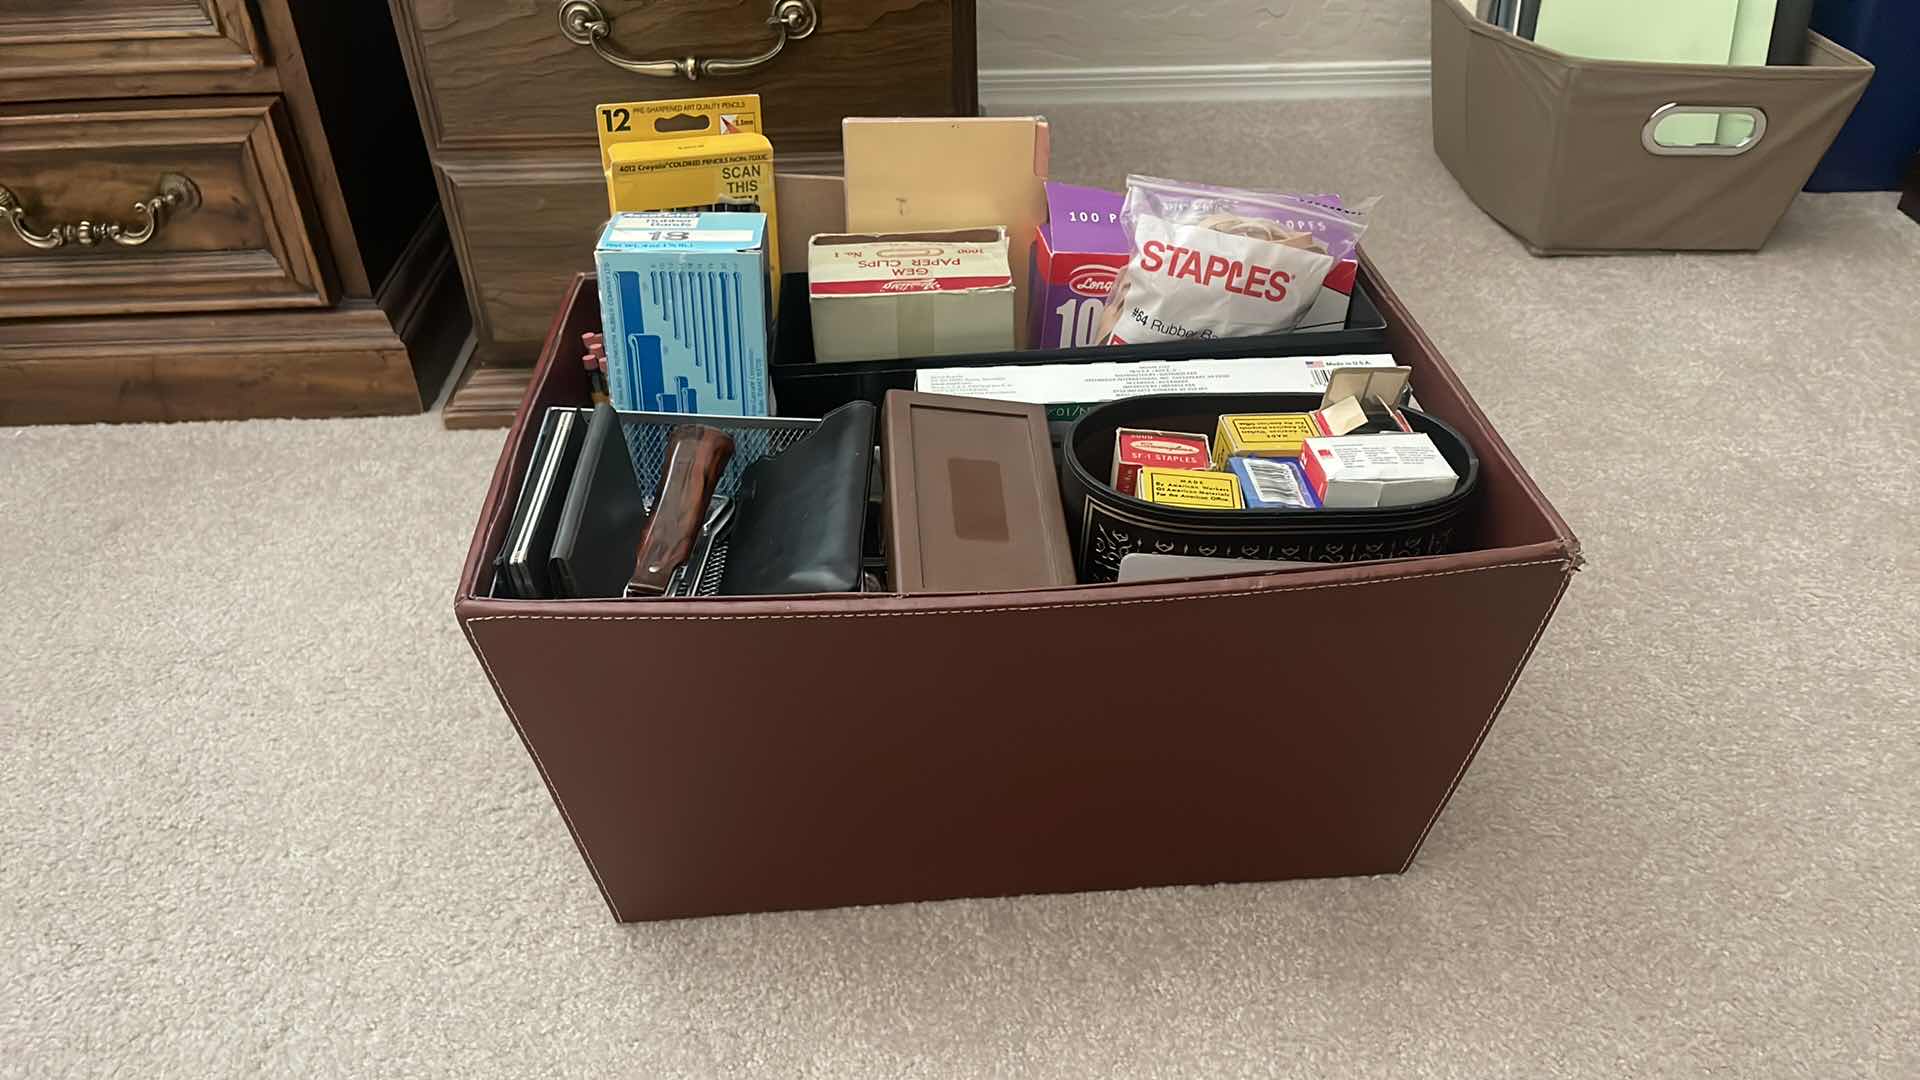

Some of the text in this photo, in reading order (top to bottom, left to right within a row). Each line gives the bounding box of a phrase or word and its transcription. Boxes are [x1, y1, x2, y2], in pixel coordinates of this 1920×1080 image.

[602, 108, 632, 133] 12
[668, 160, 701, 168] COLORED
[702, 156, 728, 165] PENCILS
[722, 165, 761, 180] SCAN
[726, 180, 758, 194] THIS
[1068, 211, 1100, 223] 100
[1109, 213, 1117, 223] P
[648, 231, 690, 241] 18
[857, 258, 961, 269] PAPER CLIPS
[891, 267, 929, 277] GEM
[1140, 239, 1291, 303] STAPLES
[1077, 277, 1114, 290] Long
[1056, 298, 1106, 349] 10
[1131, 307, 1149, 326] #64
[1200, 328, 1214, 340] B
[1155, 454, 1198, 464] STAPLES
